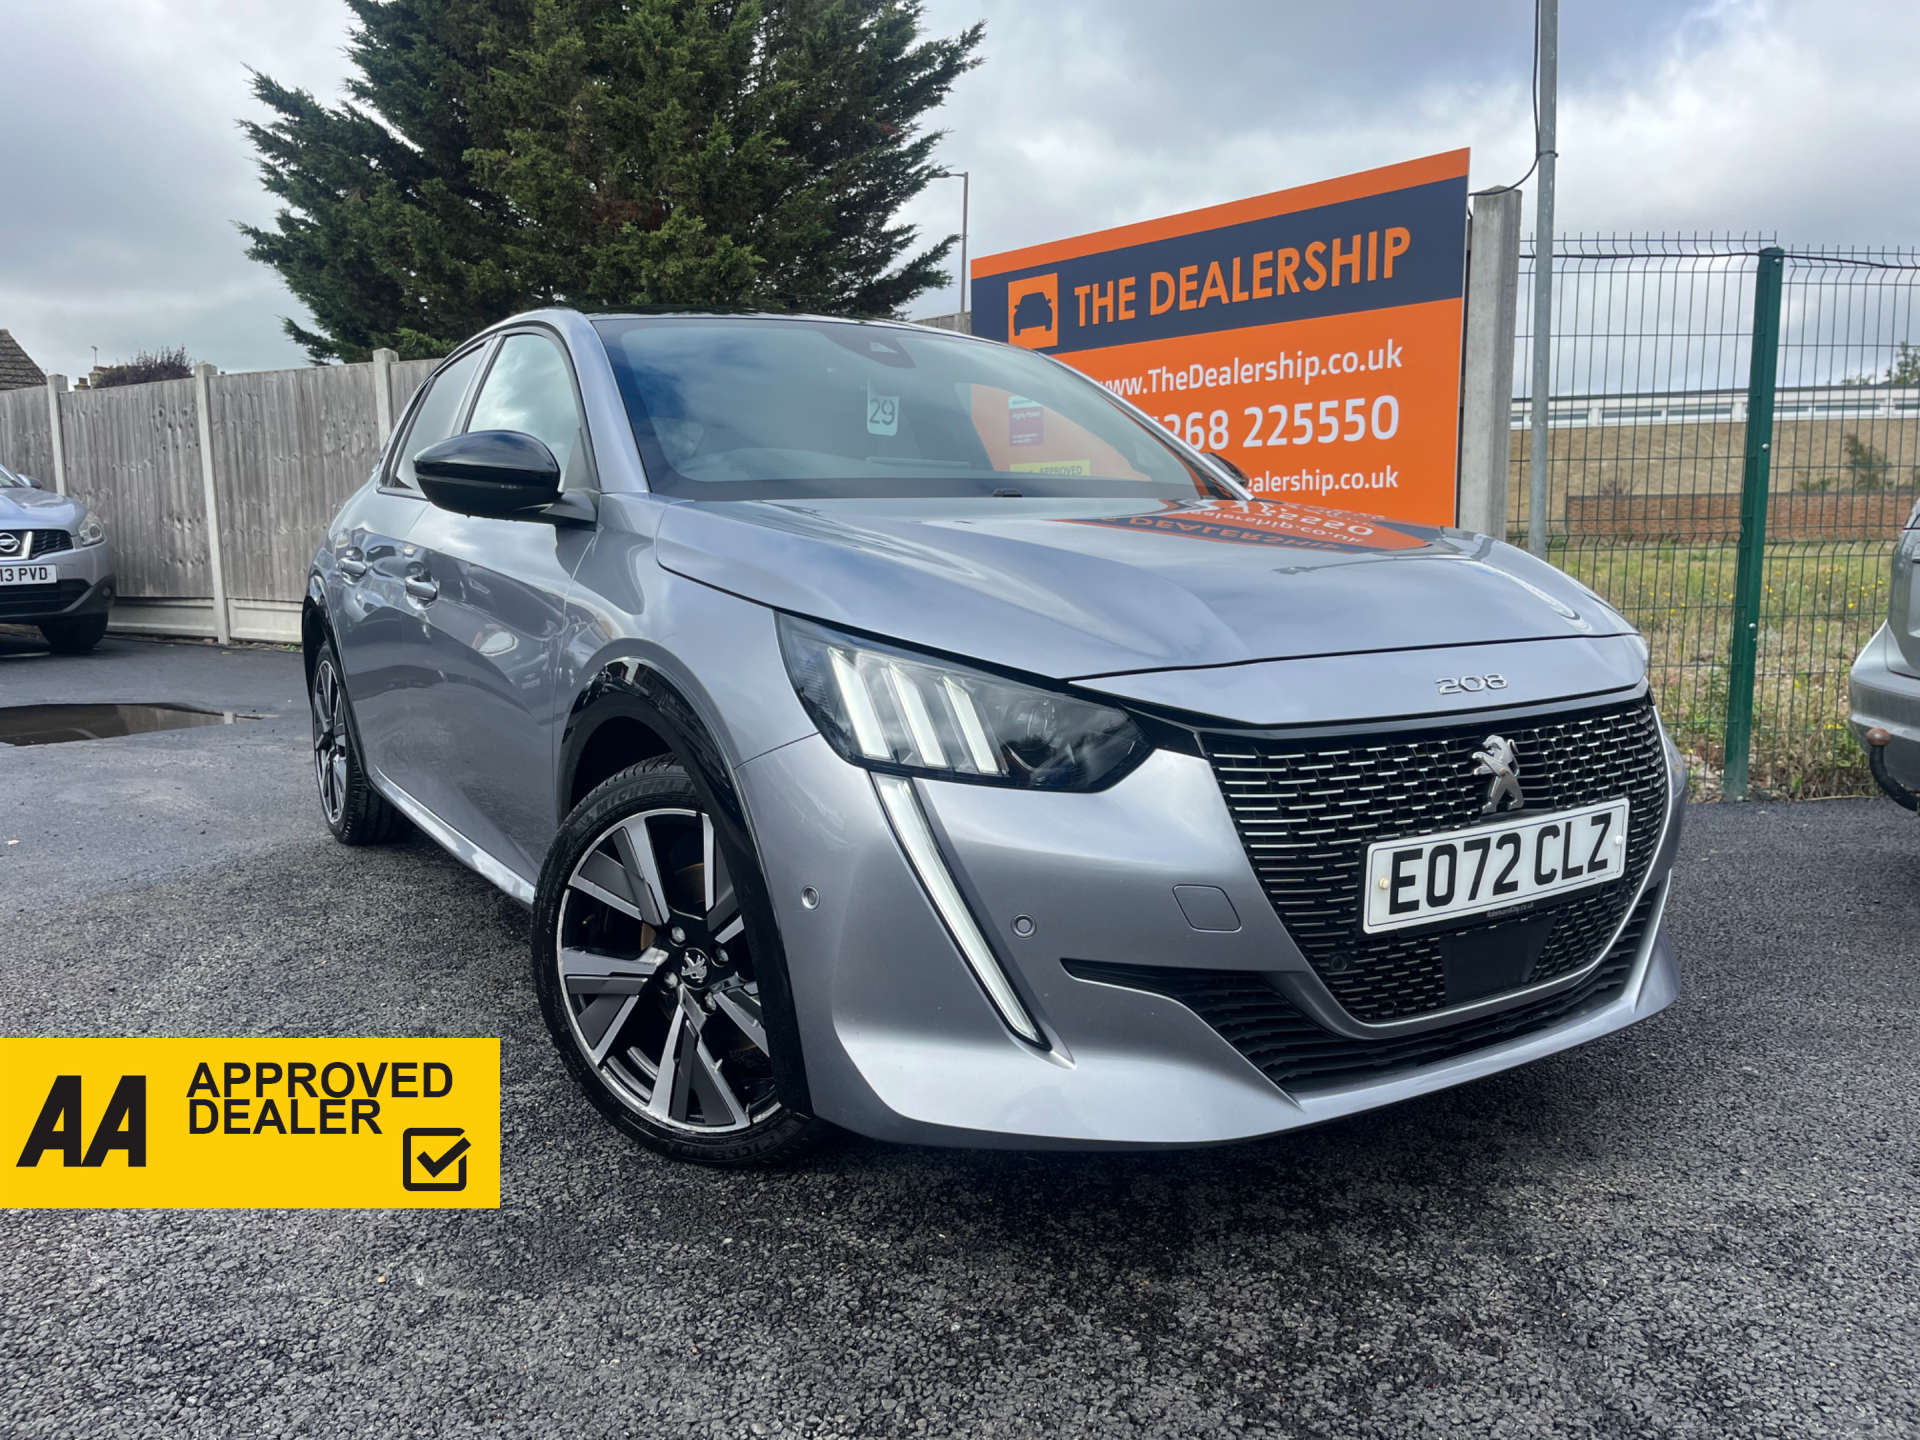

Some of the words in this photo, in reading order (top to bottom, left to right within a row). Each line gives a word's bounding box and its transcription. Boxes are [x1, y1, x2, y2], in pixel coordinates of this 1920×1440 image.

[1074, 275, 1136, 327] THE
[1150, 226, 1411, 316] DEALERSHIP
[1099, 338, 1403, 396] ww.TheDealership.co.uk
[868, 398, 896, 426] 29
[1151, 408, 1230, 451] 268
[1243, 394, 1400, 449] 225550
[18, 567, 48, 581] PVD
[1435, 673, 1508, 695] 208
[1533, 812, 1613, 886] CLZ
